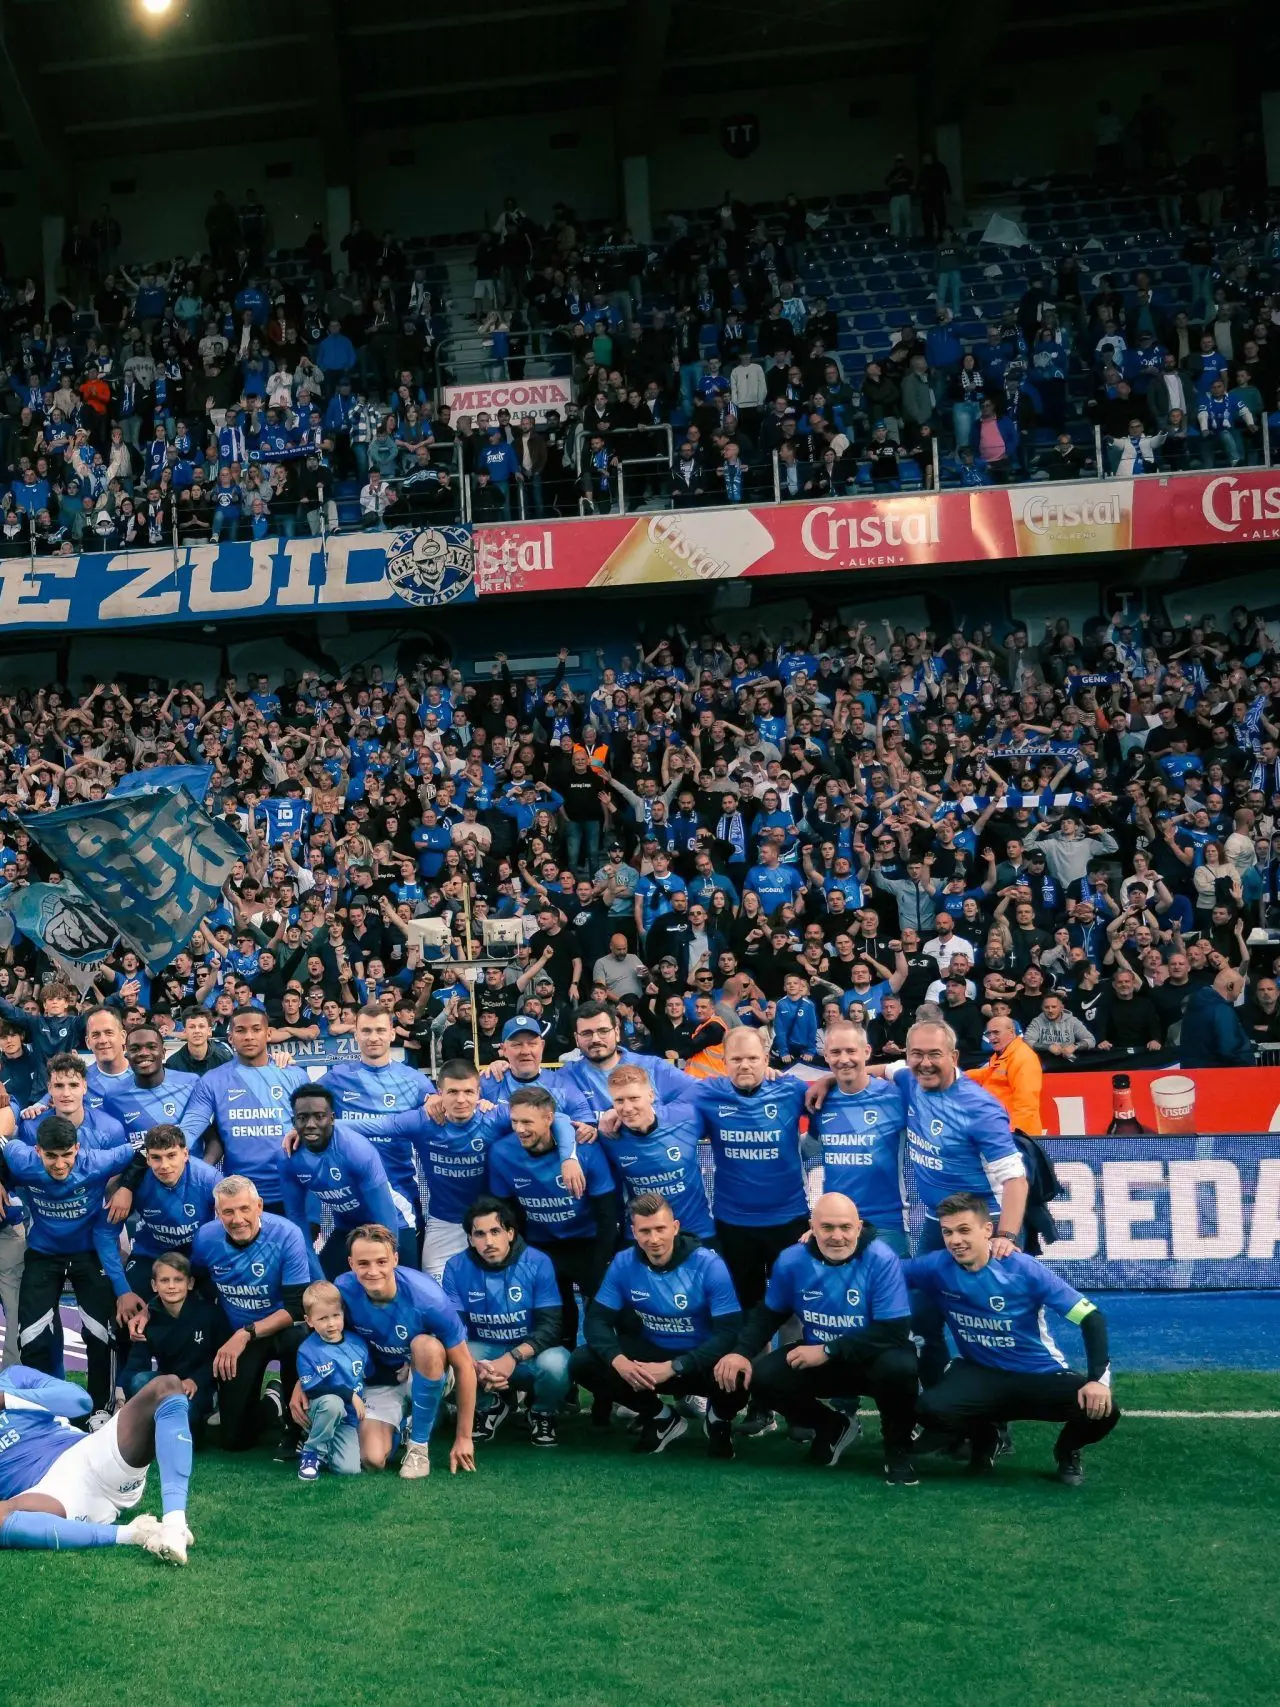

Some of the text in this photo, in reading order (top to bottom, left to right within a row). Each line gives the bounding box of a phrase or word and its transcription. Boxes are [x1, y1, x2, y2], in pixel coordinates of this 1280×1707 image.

[726, 124, 753, 143] TT
[451, 384, 569, 411] MECONA
[1023, 494, 1121, 536] Cristal
[801, 504, 941, 561] Cristal
[848, 556, 896, 567] ALKEN
[98, 530, 402, 620] ZUID
[1081, 675, 1108, 685] GENK
[228, 1107, 284, 1120] BEDANKT
[232, 1124, 283, 1137] GENKIES
[720, 1128, 782, 1143] BEDANKT
[821, 1133, 876, 1147] BEDANKT
[429, 1151, 486, 1165] BEDANKT
[724, 1147, 779, 1161] GENKIES
[824, 1152, 873, 1166] GENKIES
[433, 1164, 485, 1178] GENKIES
[626, 1167, 685, 1185] BEDANKT
[633, 1181, 686, 1196] GENKIES
[32, 1196, 89, 1210] BEDANKT
[517, 1195, 574, 1208] BEDANKT
[37, 1208, 88, 1220] GENKIES
[526, 1209, 577, 1223] GENKIES
[147, 1221, 200, 1236] BEDANKT
[216, 1282, 269, 1296] BEDANKT
[470, 1310, 528, 1326] BEDANKT
[803, 1309, 865, 1328] BEDANKT
[948, 1311, 1013, 1332] BEDANKT
[476, 1327, 529, 1341] GENKIES
[958, 1330, 1016, 1348] GENKIES
